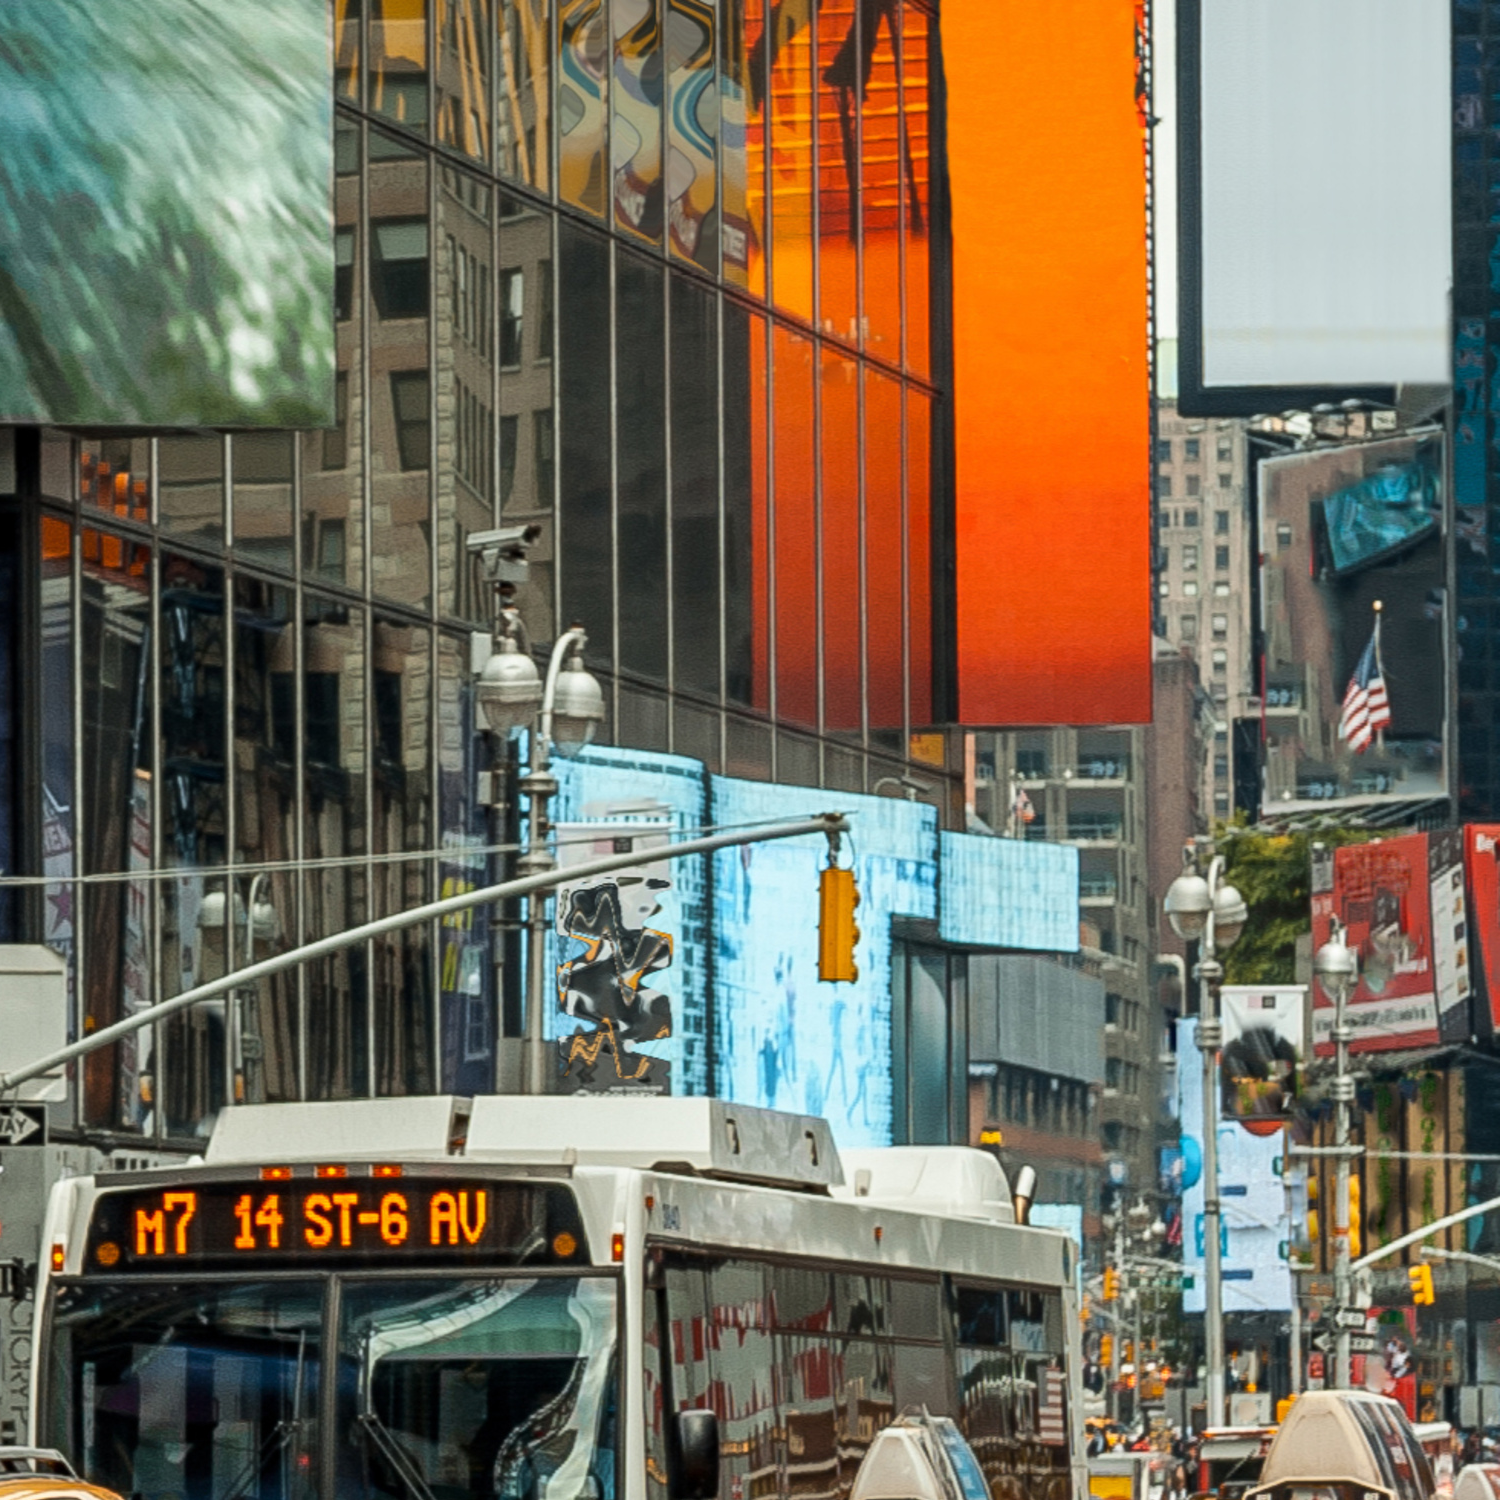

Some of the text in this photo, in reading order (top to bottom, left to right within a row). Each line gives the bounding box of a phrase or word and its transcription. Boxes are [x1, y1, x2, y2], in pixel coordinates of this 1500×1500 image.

[234, 1194, 284, 1249] 14
[304, 1192, 409, 1246] ST-6
[429, 1190, 487, 1245] AV
